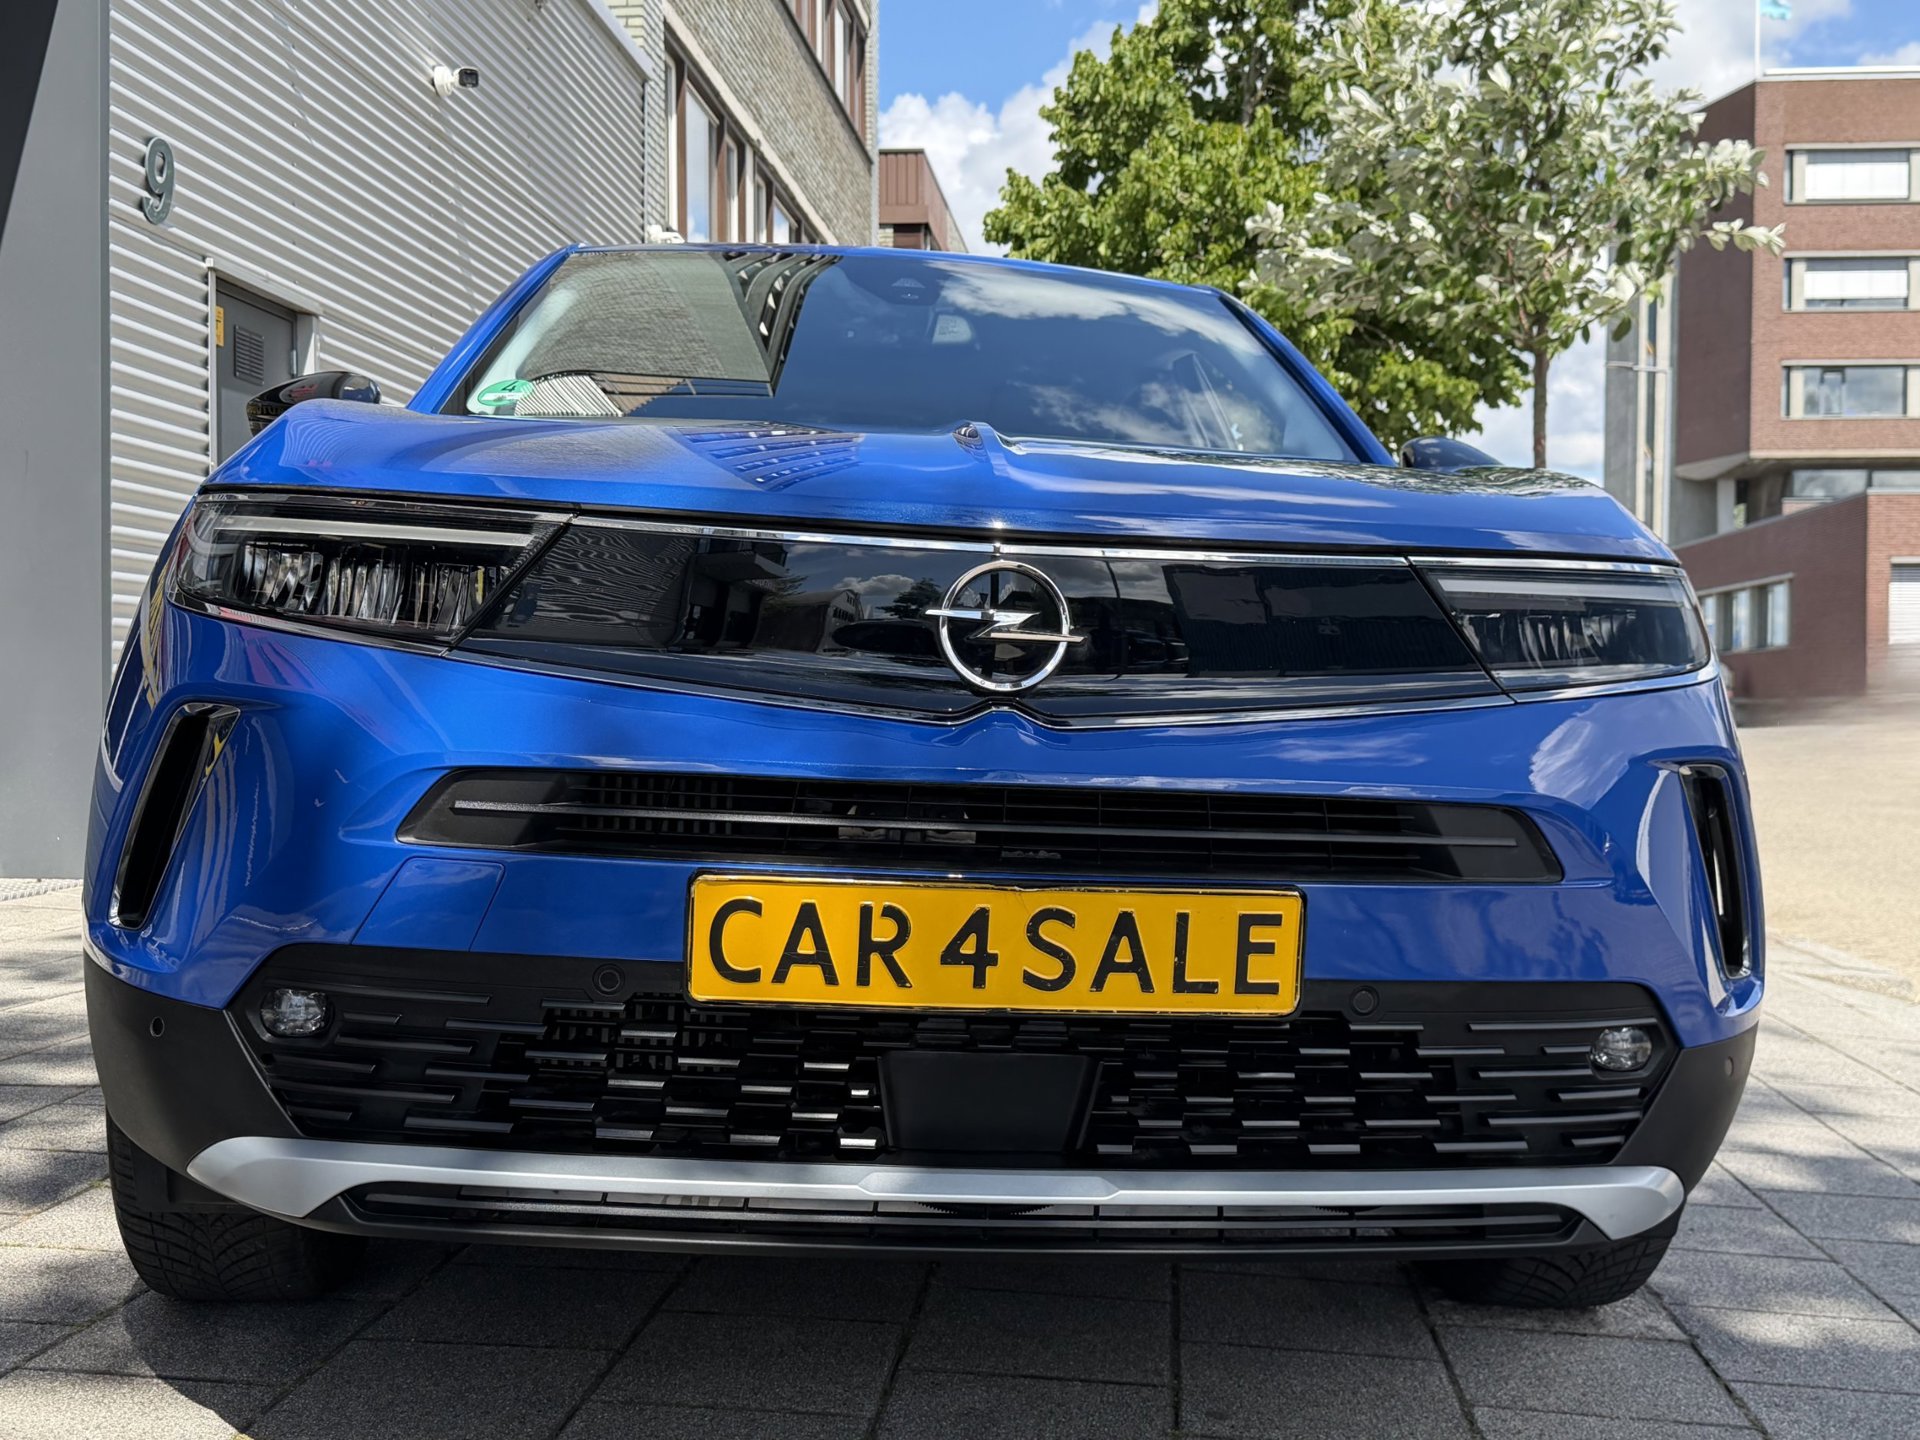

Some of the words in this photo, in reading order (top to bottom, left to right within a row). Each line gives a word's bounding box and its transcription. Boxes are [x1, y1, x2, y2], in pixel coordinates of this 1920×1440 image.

[142, 136, 175, 225] 9
[500, 380, 518, 392] 4
[708, 895, 913, 989] CAR
[939, 904, 999, 990] 4
[1022, 904, 1284, 996] SALE
